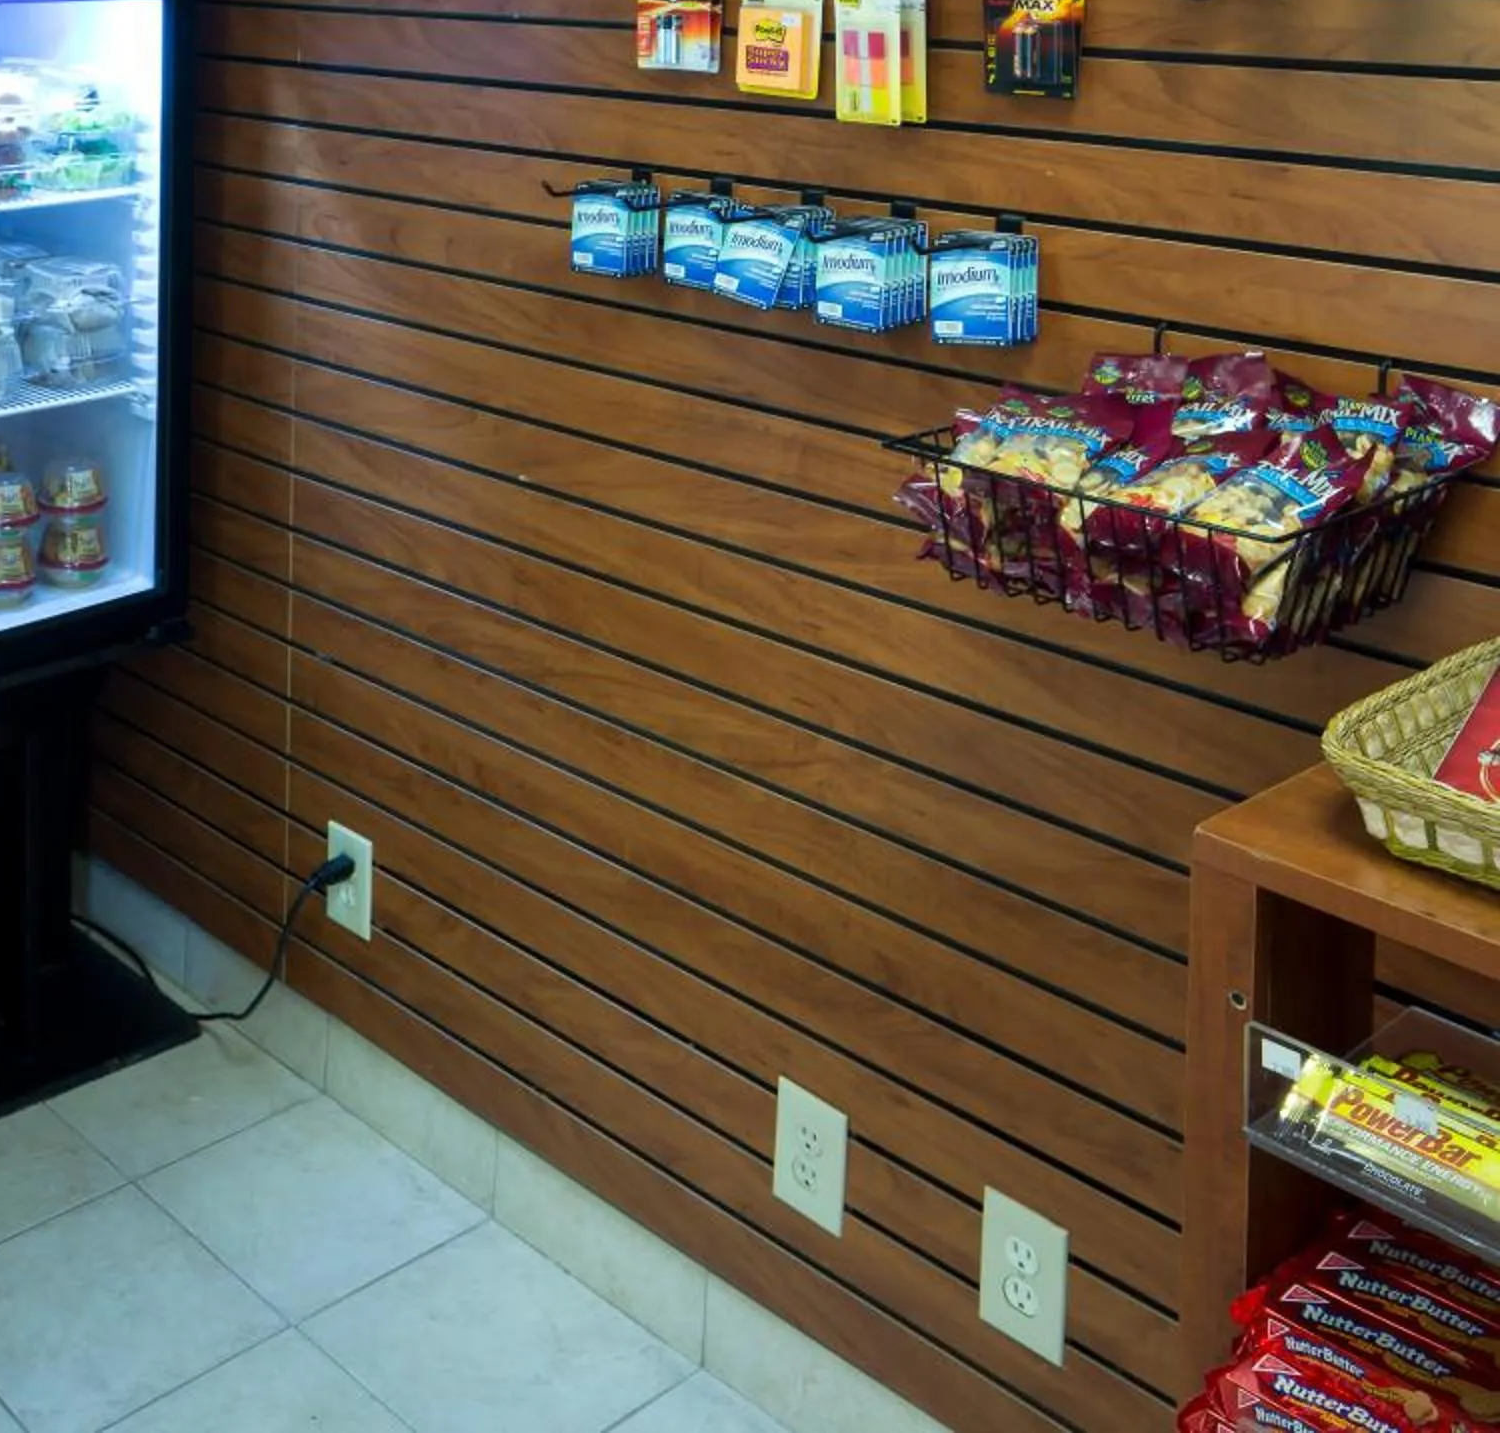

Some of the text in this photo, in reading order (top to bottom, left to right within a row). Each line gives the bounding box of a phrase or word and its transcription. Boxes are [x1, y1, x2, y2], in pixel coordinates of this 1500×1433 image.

[729, 231, 784, 252] Imodium
[821, 253, 876, 274] Imodium
[937, 266, 1000, 286] Imodium
[1328, 1083, 1483, 1169] PowerBar
[1363, 1161, 1423, 1197] CHOCOLATE
[1337, 1269, 1486, 1337] NutterButter
[1301, 1303, 1452, 1377] NutterButter
[1272, 1374, 1404, 1433] NutterButt
